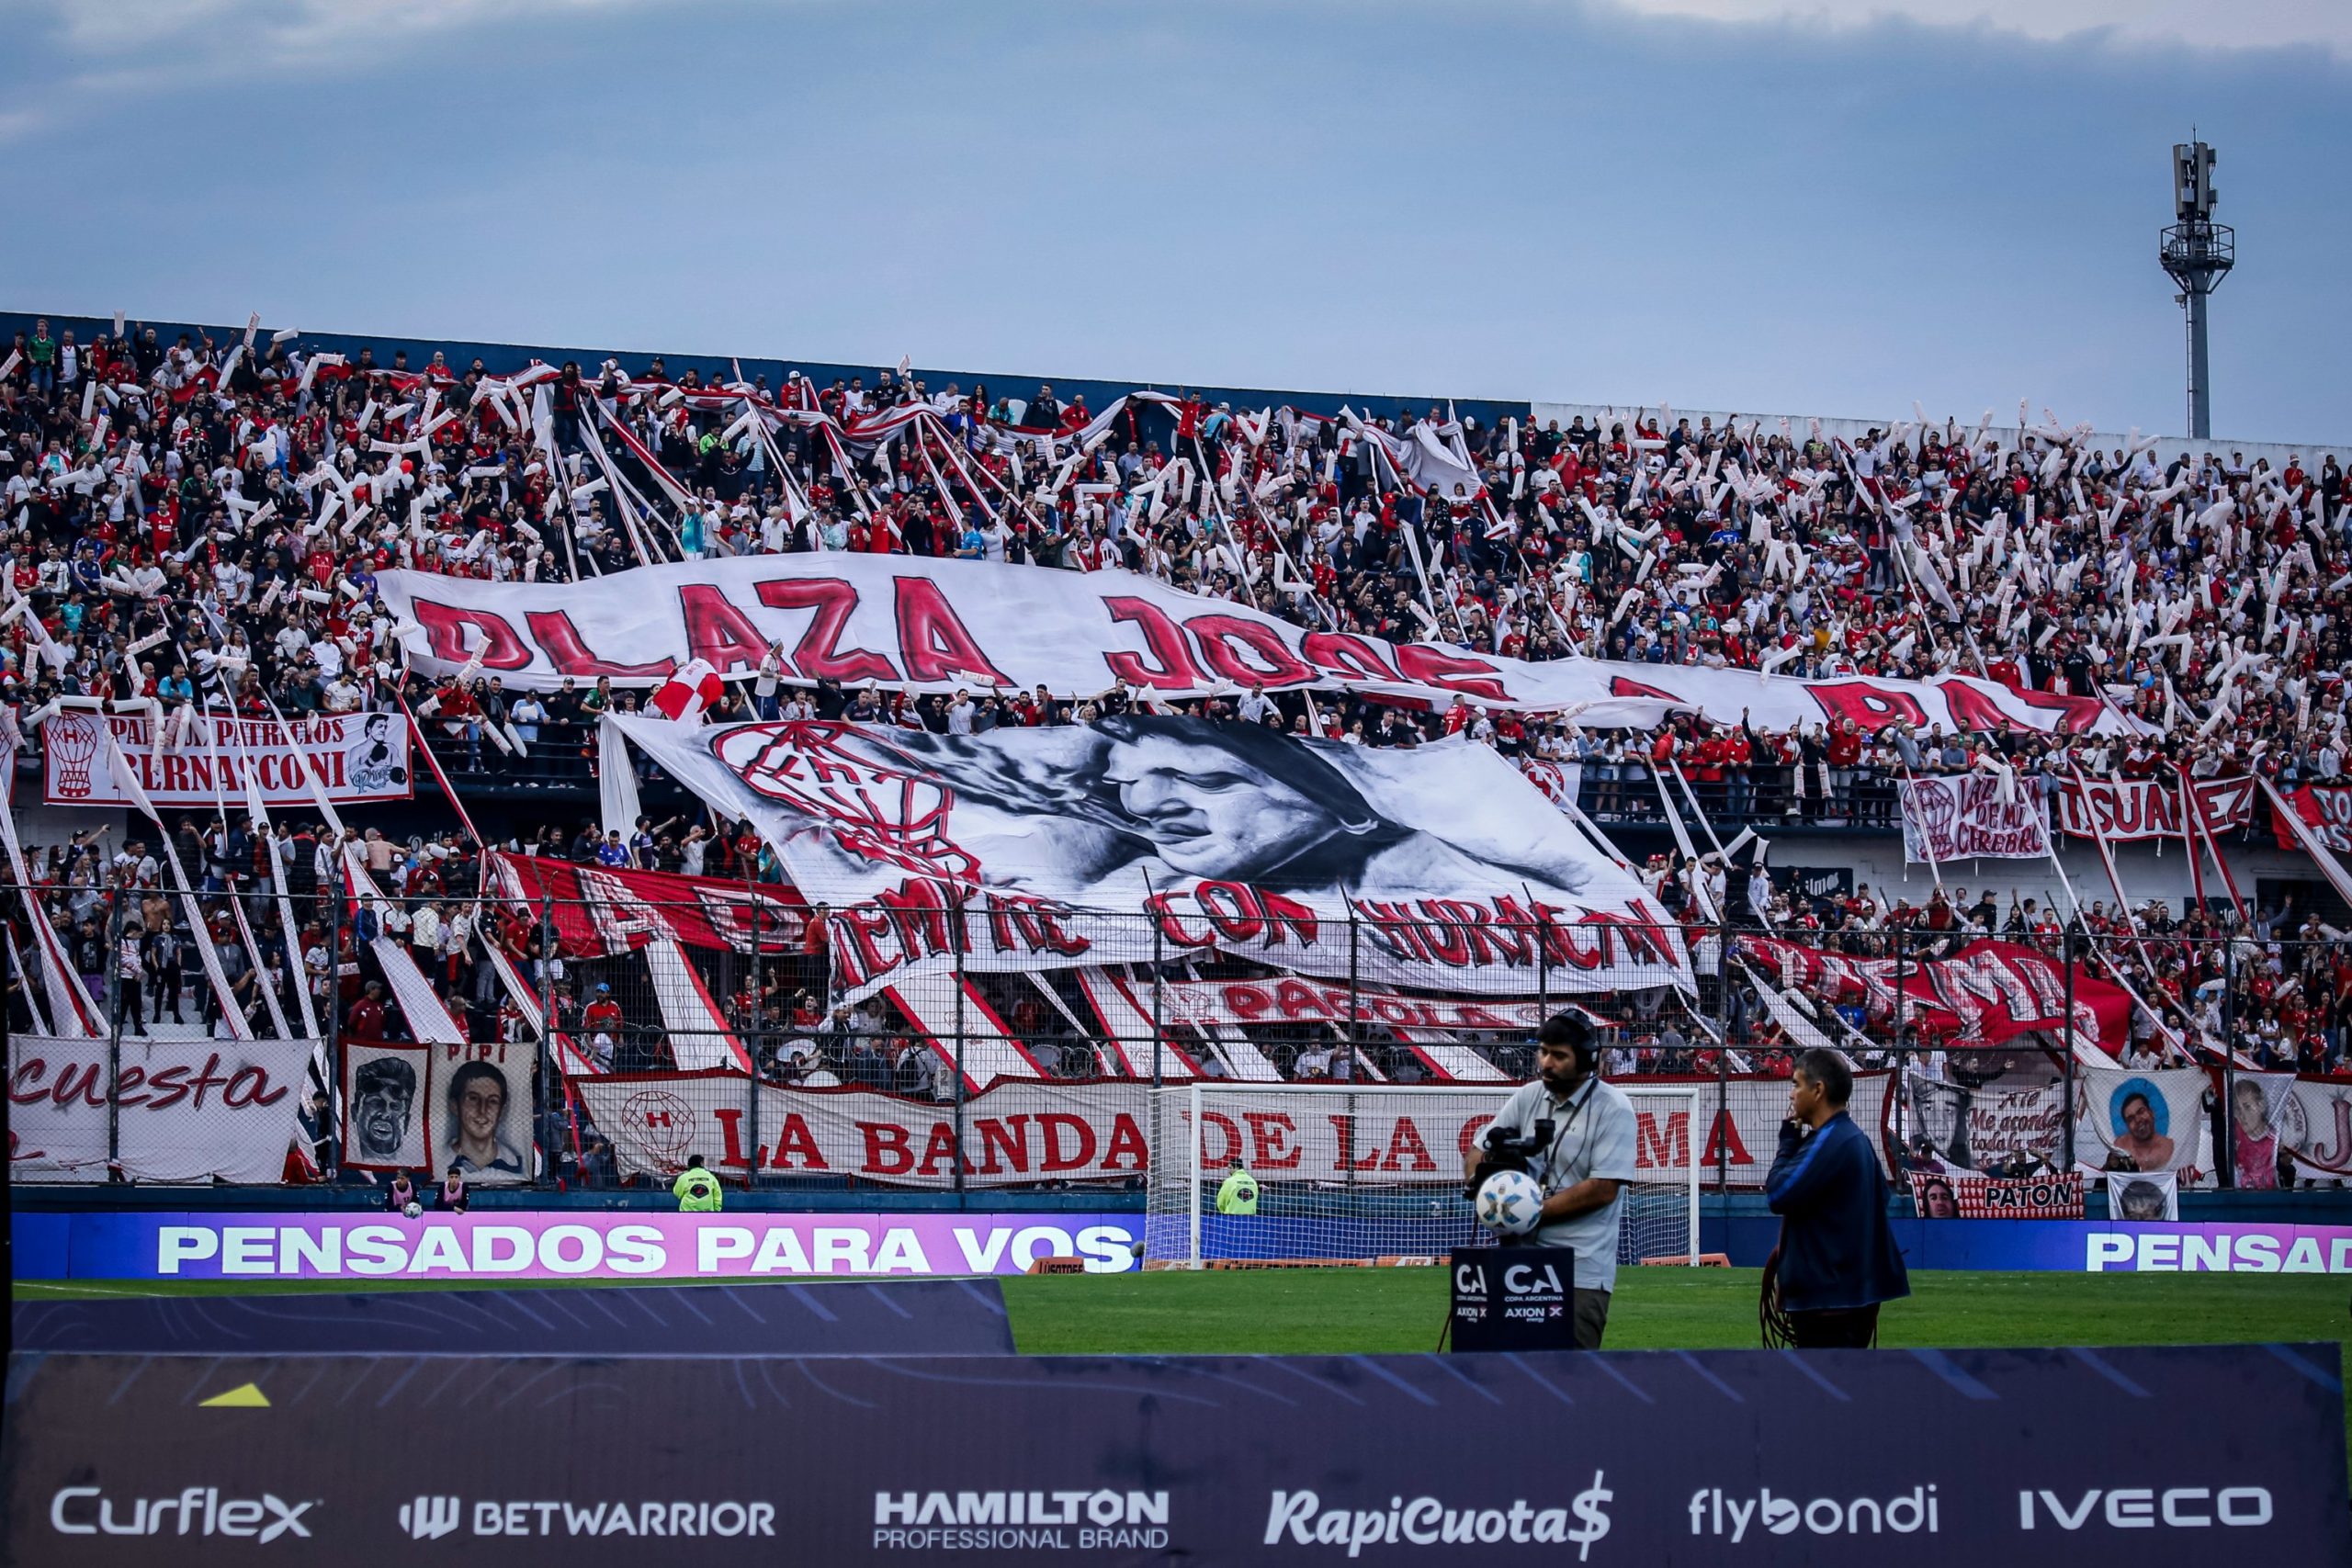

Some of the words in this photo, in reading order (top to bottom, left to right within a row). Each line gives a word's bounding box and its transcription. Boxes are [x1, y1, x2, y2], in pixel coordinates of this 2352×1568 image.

[216, 718, 345, 747] PATRICIOS
[1142, 881, 1318, 950] CON
[8, 1053, 288, 1110] cuesta
[715, 1109, 829, 1169] LA
[854, 1112, 1148, 1176] BANDA
[1181, 1111, 1302, 1170] DE
[1329, 1113, 1436, 1171] LA
[1985, 1183, 2073, 1209] PATON
[157, 1225, 667, 1275] PENSADOS
[696, 1227, 932, 1273] PARA
[952, 1225, 1135, 1274] VOS
[1504, 1264, 1564, 1293] CA
[1456, 1306, 1478, 1317] AXION
[1505, 1307, 1545, 1317] AXION
[51, 1487, 313, 1544] Curflex
[475, 1502, 775, 1536] BETWARRIOR
[876, 1489, 1170, 1524] HAMILTON
[1264, 1470, 1613, 1562] RapiCuota$
[1689, 1484, 1939, 1542] flybondi
[2020, 1487, 2273, 1529] IVECO
[874, 1529, 1070, 1550] PROFESSIONAL
[1079, 1529, 1169, 1550] BRAND
